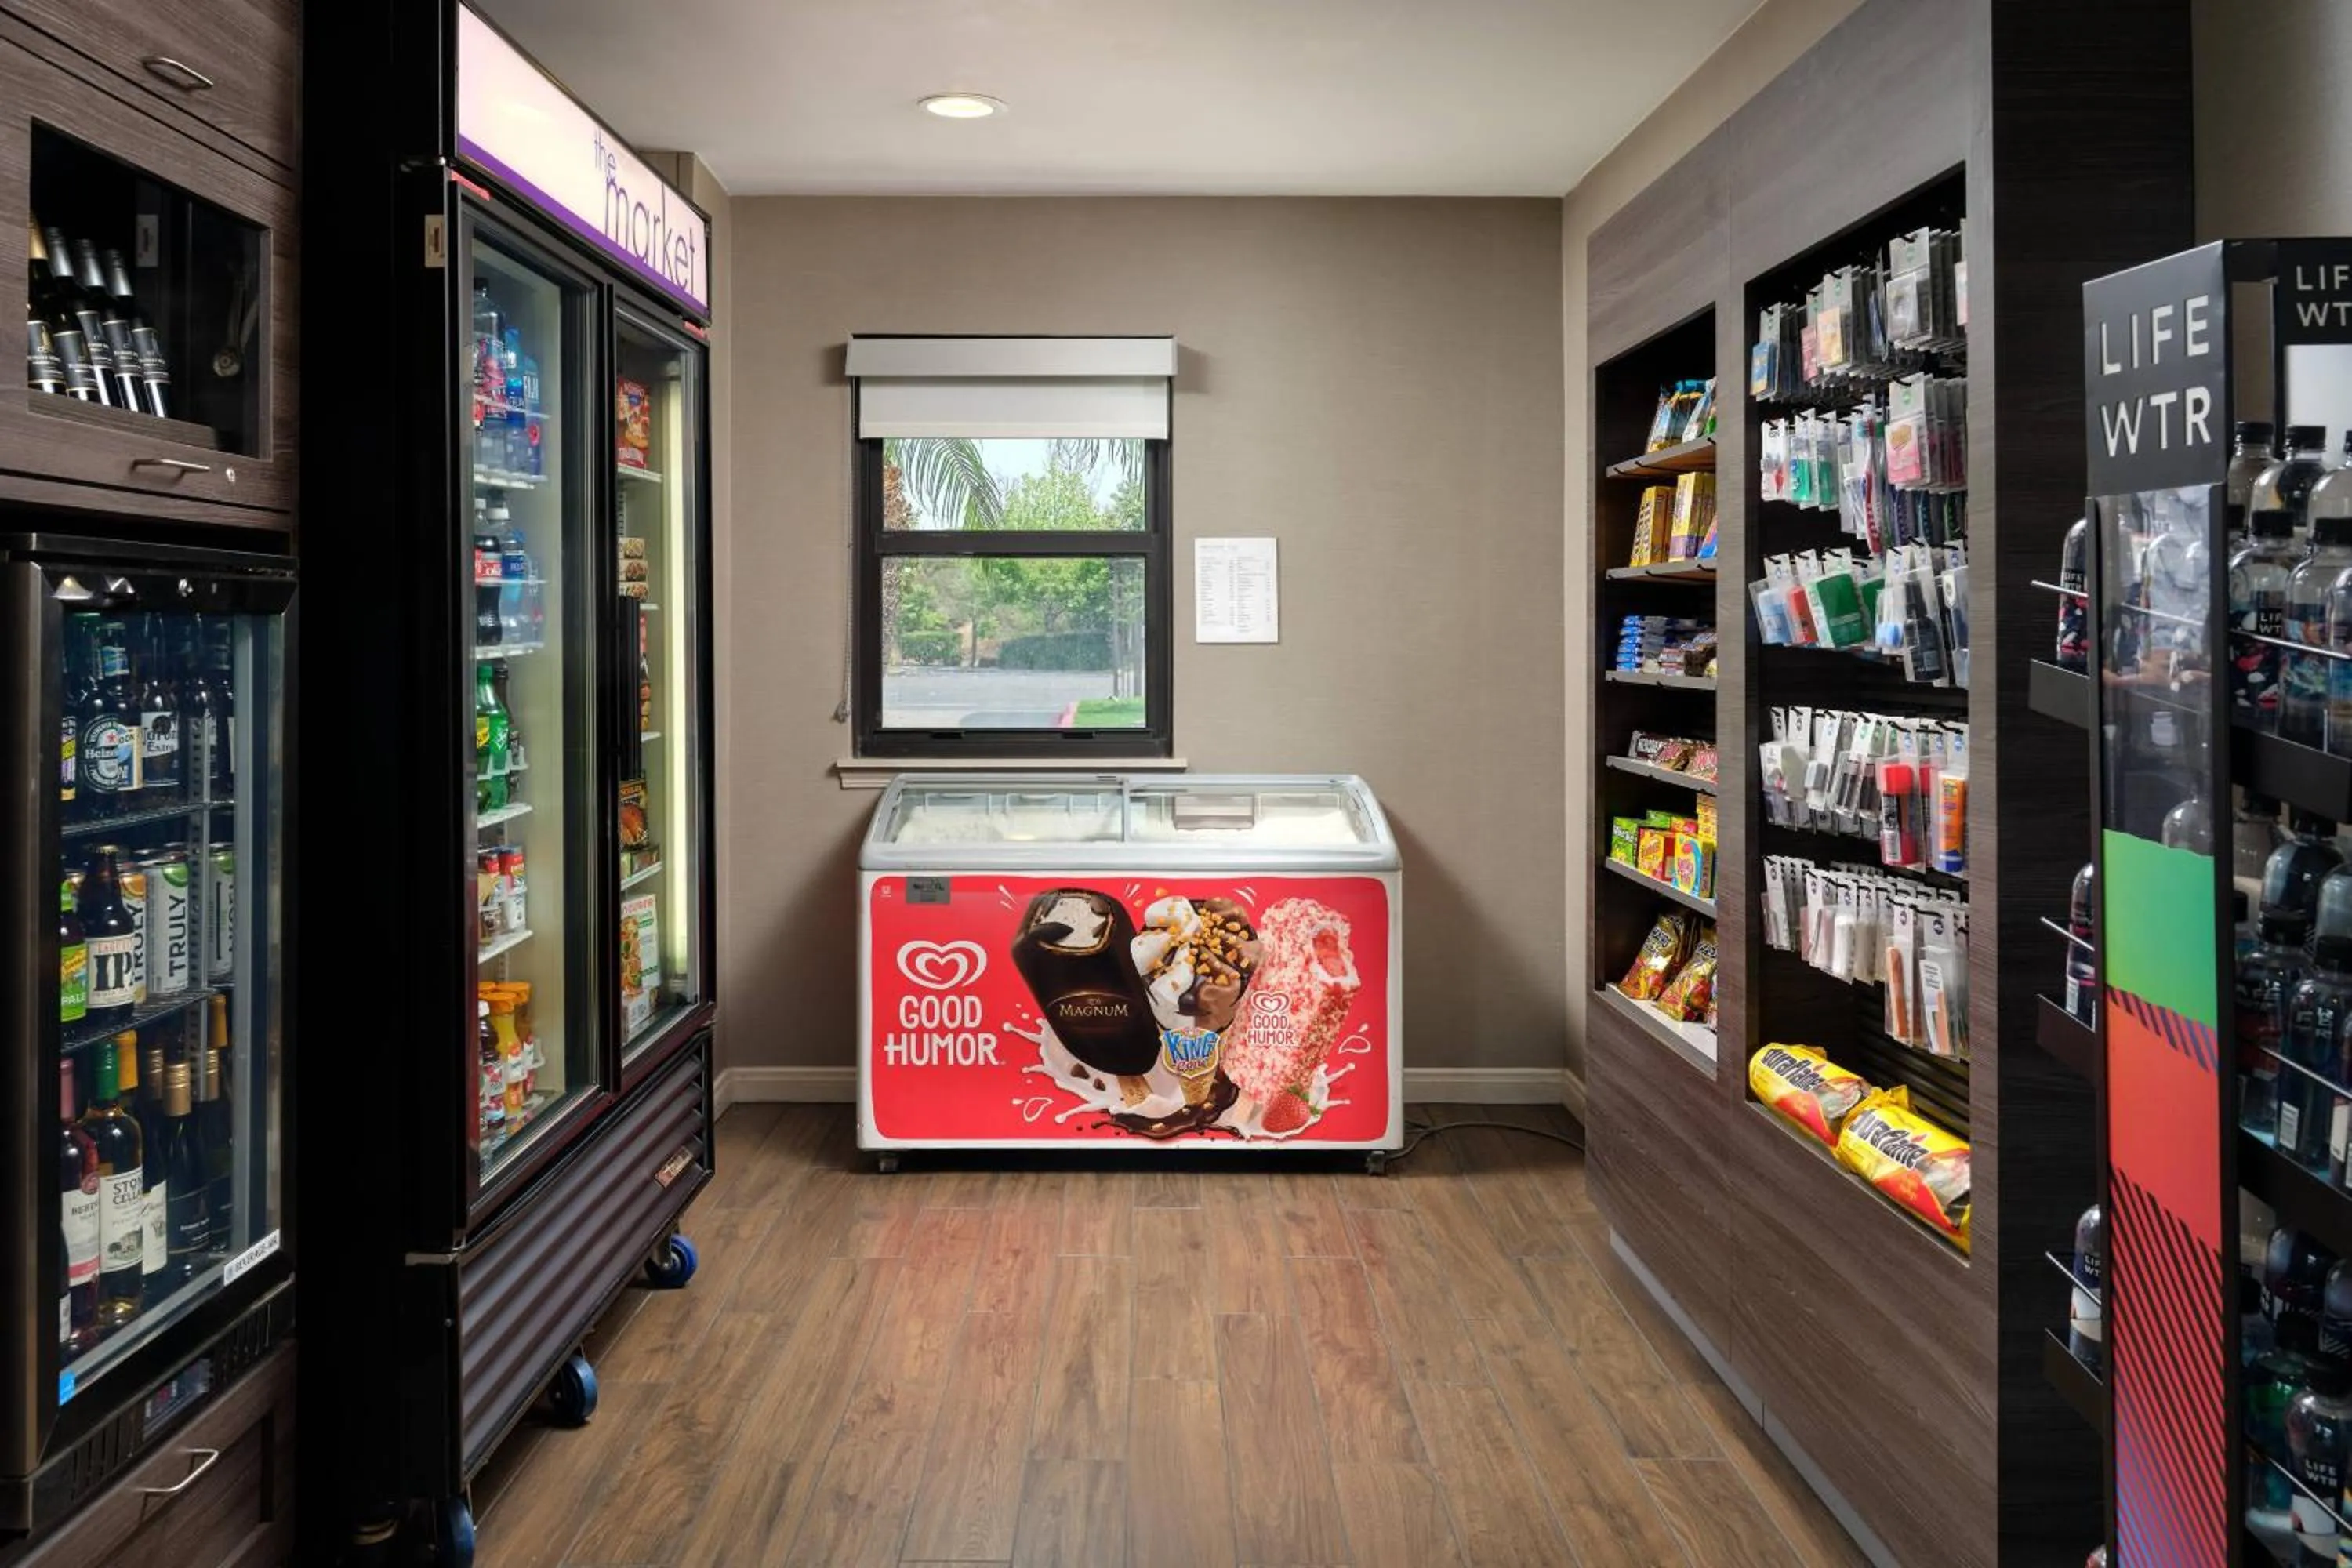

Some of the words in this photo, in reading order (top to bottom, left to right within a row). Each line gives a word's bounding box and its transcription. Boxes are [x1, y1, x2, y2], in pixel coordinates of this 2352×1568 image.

[593, 128, 616, 174] the
[605, 174, 695, 296] market
[2296, 264, 2350, 291] LIF
[2296, 302, 2352, 327] WT
[2100, 294, 2209, 376] LIFE
[2100, 387, 2212, 458] WTR
[2259, 624, 2283, 634] WT
[2260, 612, 2283, 622] LIF
[169, 894, 187, 978] TRULY
[899, 994, 982, 1029] GOOD
[1059, 1002, 1129, 1017] MAGNUM
[1254, 1014, 1287, 1028] GOOD
[884, 1032, 1000, 1067] HUMOR
[1163, 1029, 1218, 1063] KING
[1247, 1030, 1293, 1044] HUMOR
